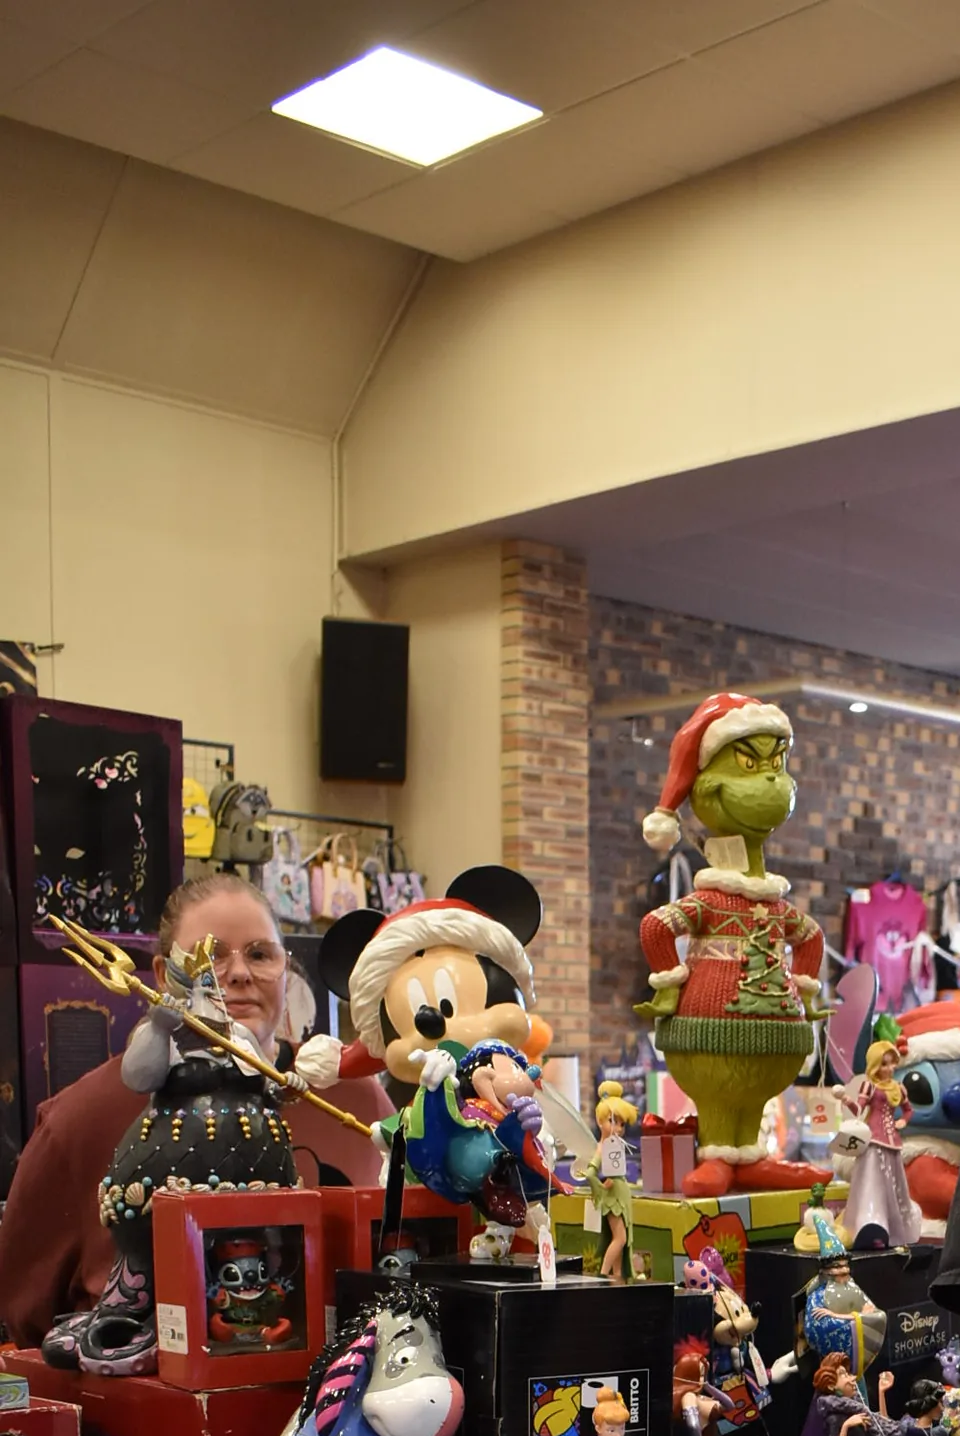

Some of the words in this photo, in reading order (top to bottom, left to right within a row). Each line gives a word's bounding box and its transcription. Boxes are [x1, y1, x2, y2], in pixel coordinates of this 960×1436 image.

[897, 1311, 940, 1333] Disney
[894, 1331, 947, 1353] SHOWCASE
[629, 1377, 640, 1424] BRITTO
